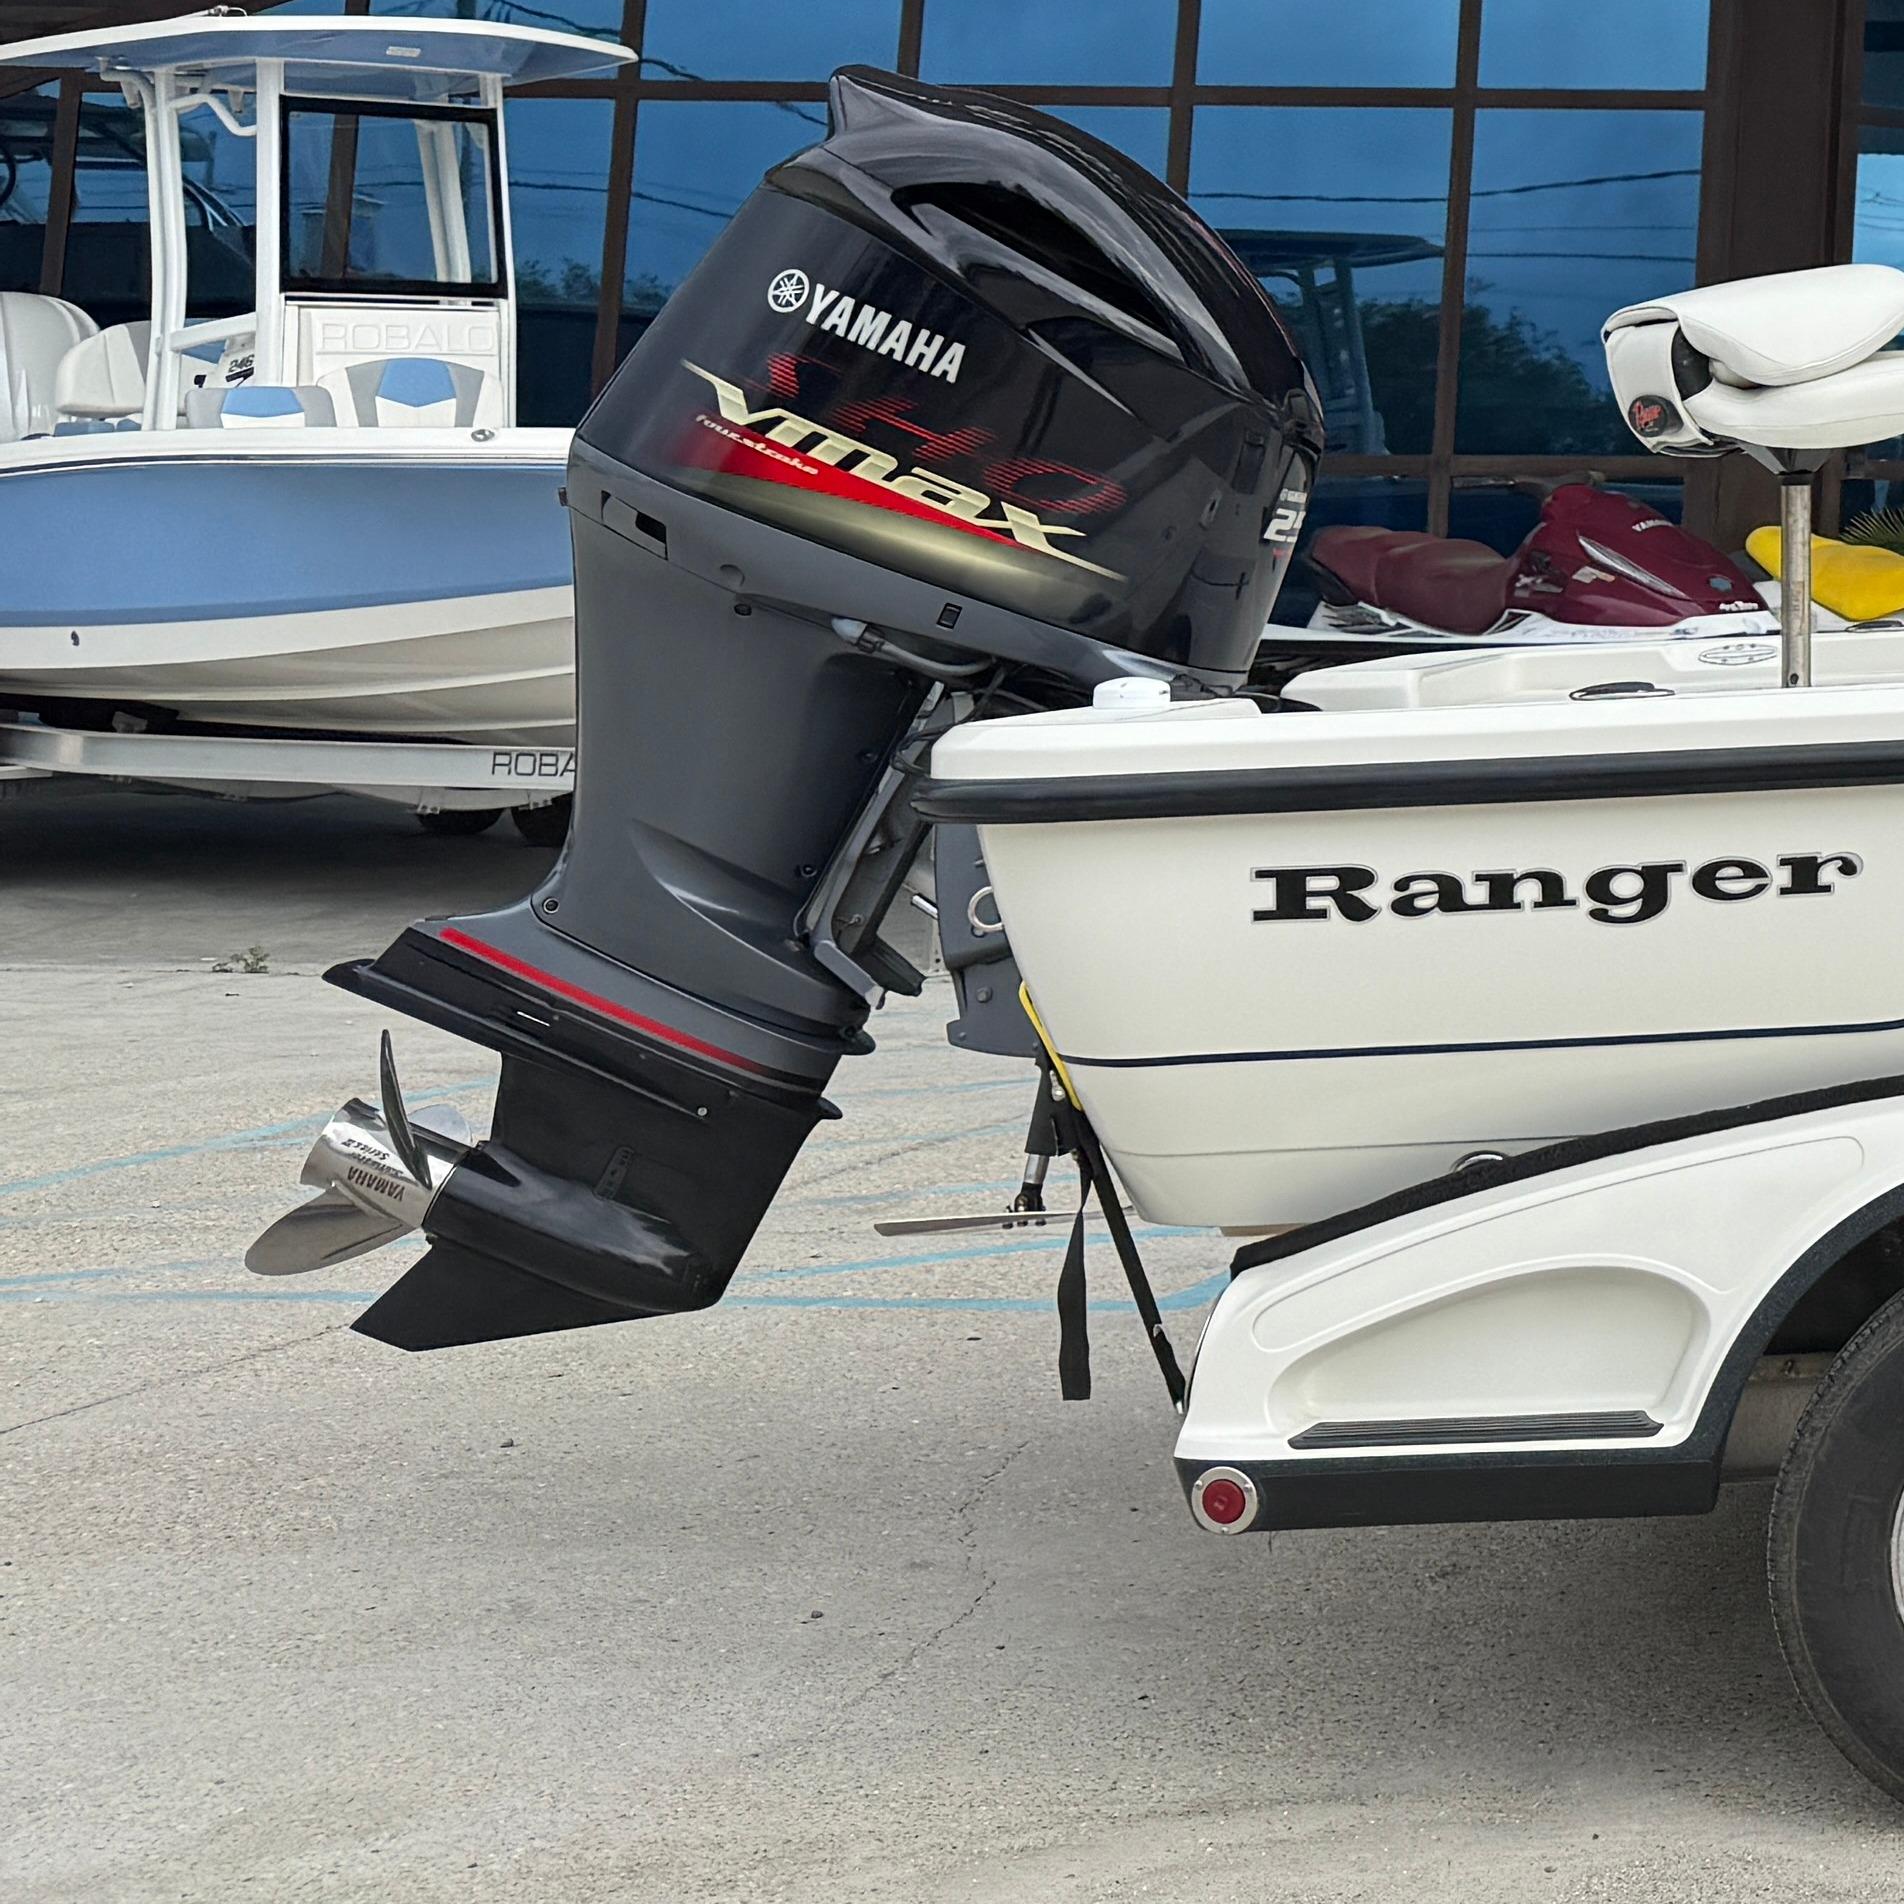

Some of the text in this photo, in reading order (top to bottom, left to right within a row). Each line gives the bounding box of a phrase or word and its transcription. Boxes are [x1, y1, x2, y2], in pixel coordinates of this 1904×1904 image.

[321, 322, 496, 353] ROBALO
[804, 283, 967, 384] YAMAHA
[1250, 851, 1864, 926] Ranger
[346, 1165, 406, 1203] YAMAHA
